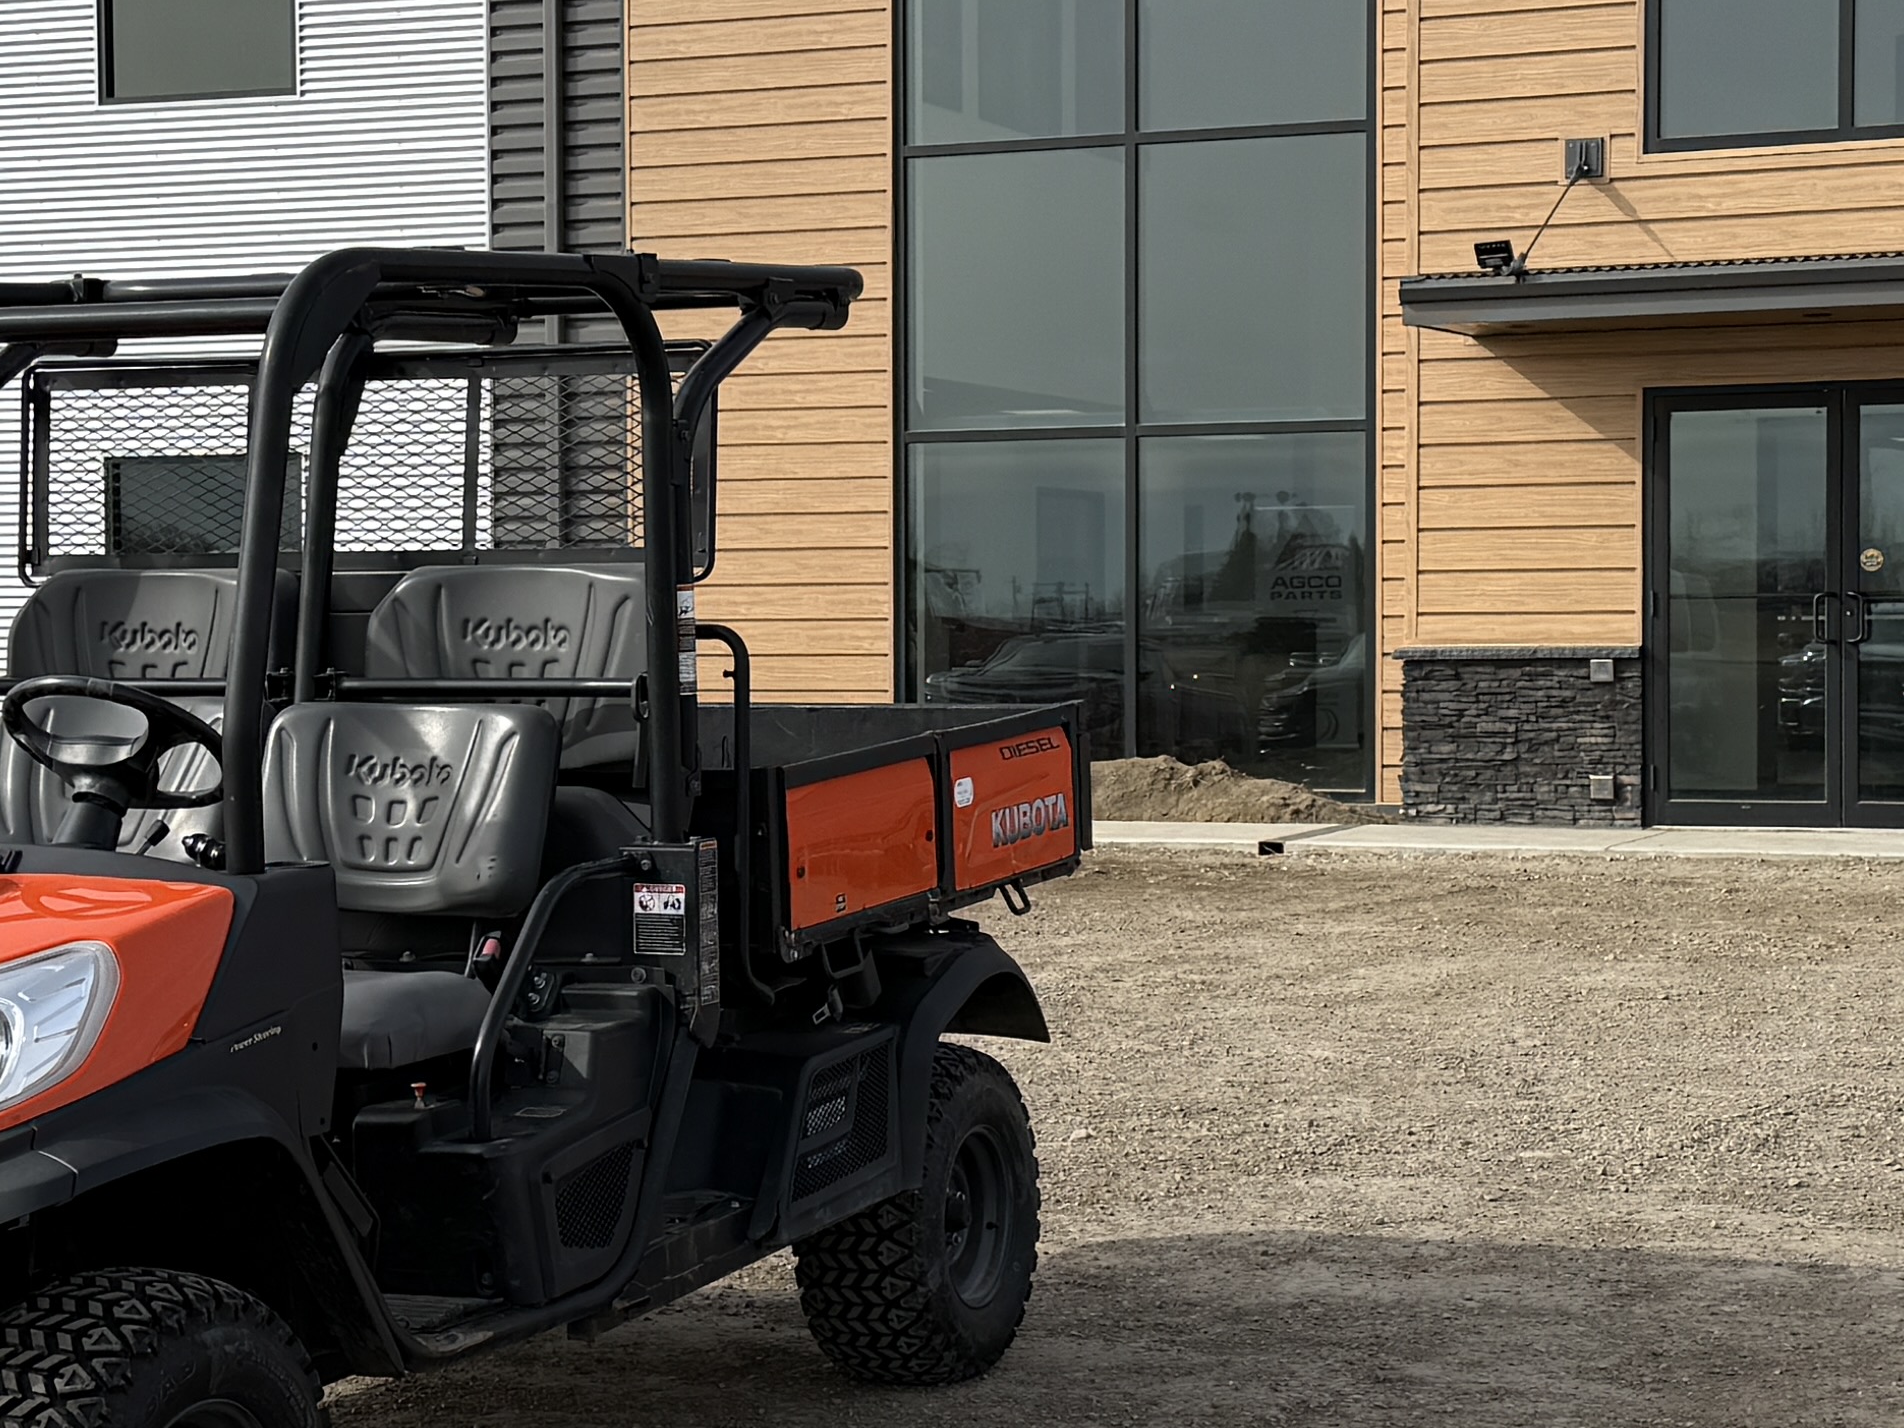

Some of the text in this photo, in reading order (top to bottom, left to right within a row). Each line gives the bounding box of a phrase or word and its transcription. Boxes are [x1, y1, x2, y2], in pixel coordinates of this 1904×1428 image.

[1270, 575, 1342, 590] AGCO
[1270, 590, 1343, 601] PARTS
[100, 621, 198, 653] Kubota
[461, 617, 570, 651] Kubota
[999, 737, 1061, 760] DIESEL
[345, 754, 453, 787] Kubota
[991, 792, 1069, 848] KUBOTA
